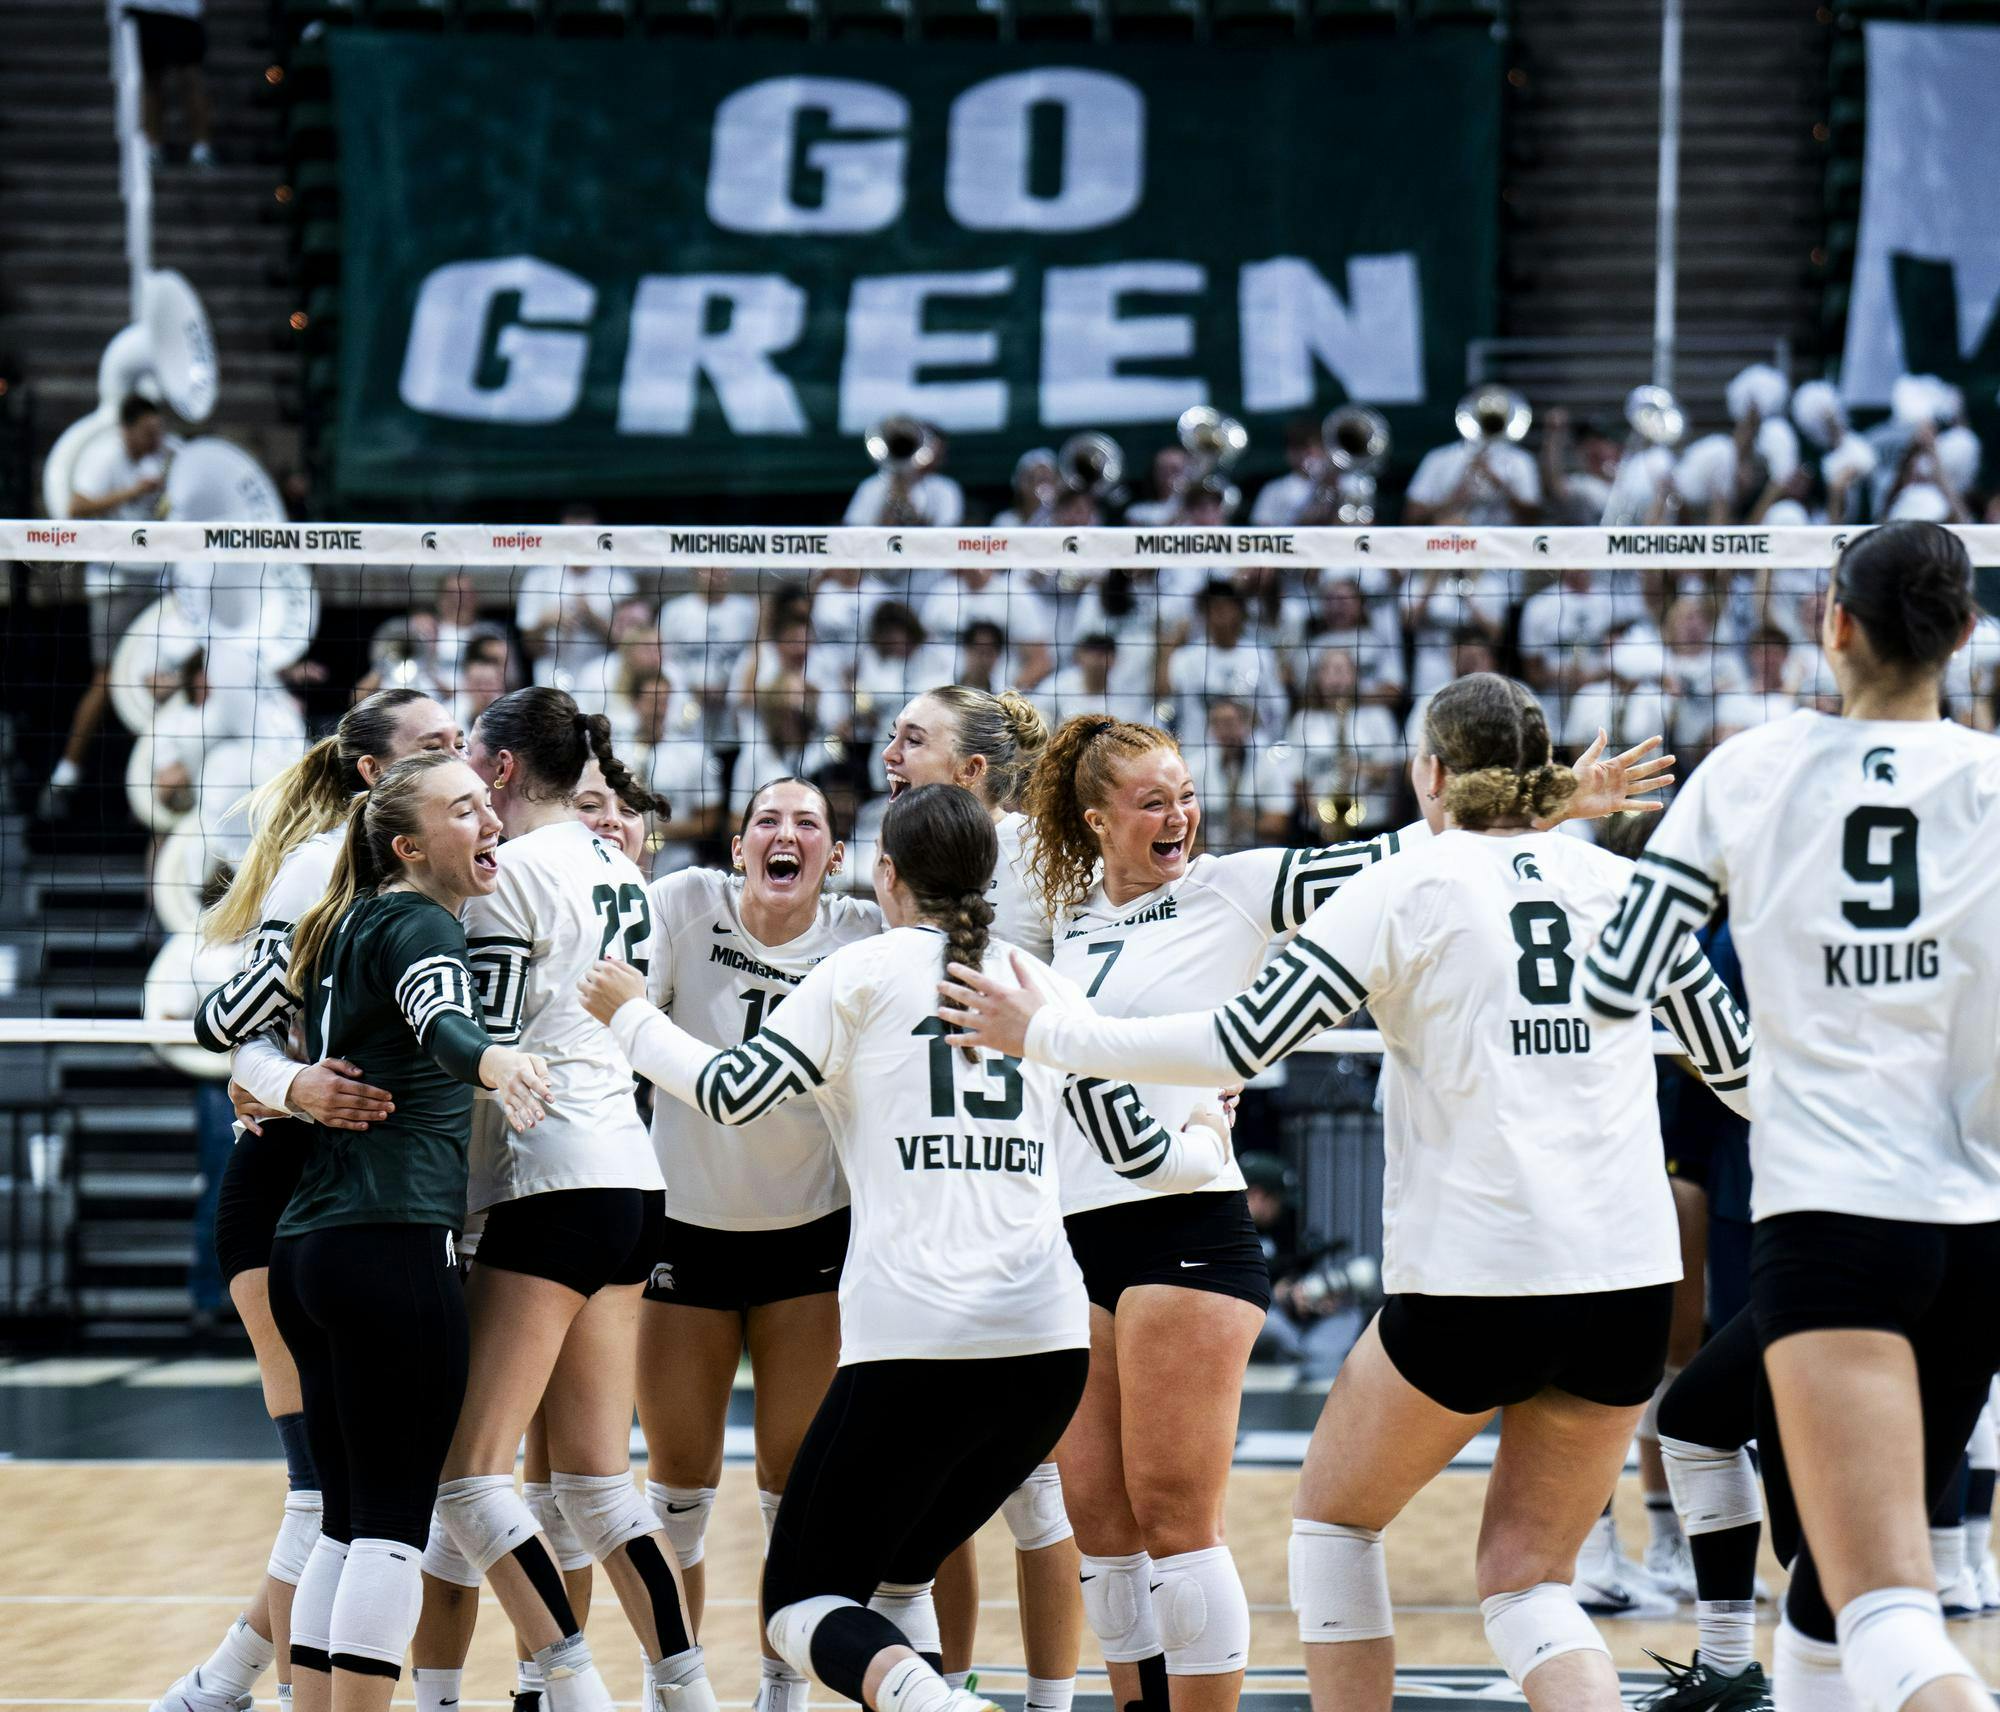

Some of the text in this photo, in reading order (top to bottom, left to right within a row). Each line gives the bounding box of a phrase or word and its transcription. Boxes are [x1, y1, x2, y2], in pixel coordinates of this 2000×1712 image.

[706, 66, 1147, 235] GO
[399, 253, 1426, 436] GREEN
[26, 529, 78, 546] meijer
[203, 529, 363, 551] MICHIGAN STATE
[492, 532, 542, 549] meijer
[669, 533, 828, 555] MICHIGAN STATE
[957, 535, 1008, 553] meijer
[1135, 534, 1295, 555] MICHIGAN STATE
[1426, 534, 1478, 553] meijer
[1608, 534, 1770, 554] MICHIGAN STATE
[1842, 805, 1920, 929] 9
[592, 883, 651, 977] 22
[1086, 940, 1125, 998] 7
[1508, 901, 1575, 1005] 8
[1821, 938, 1939, 988] KULIG
[1508, 1018, 1591, 1056] HOOD
[911, 1016, 1024, 1121] 13
[895, 1134, 1045, 1177] VELLUCCI
